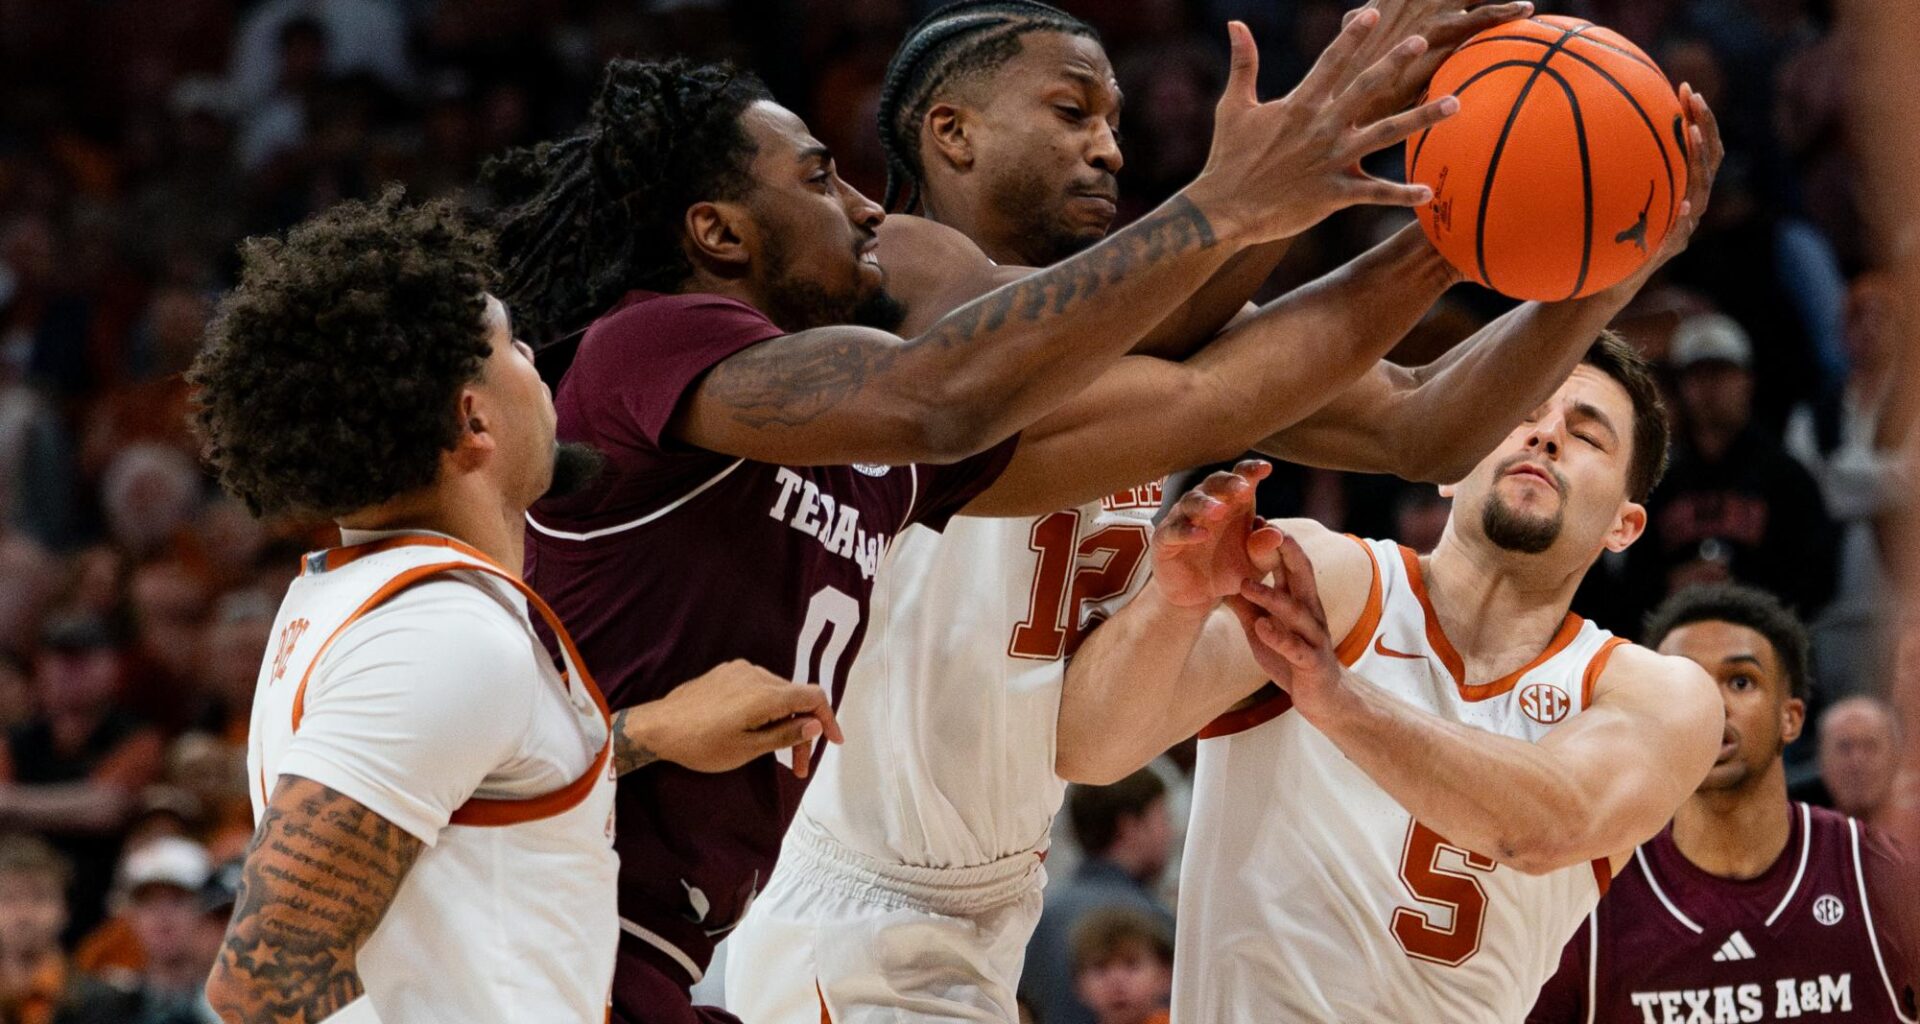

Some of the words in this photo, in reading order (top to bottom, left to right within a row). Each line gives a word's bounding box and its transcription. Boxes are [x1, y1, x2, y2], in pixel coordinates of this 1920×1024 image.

[1008, 508, 1149, 663] 12
[1520, 684, 1570, 723] SEC
[1390, 813, 1498, 968] 5
[1814, 896, 1842, 925] SEC
[1631, 983, 1764, 1024] TEXAS
[1774, 972, 1853, 1019] A&M
